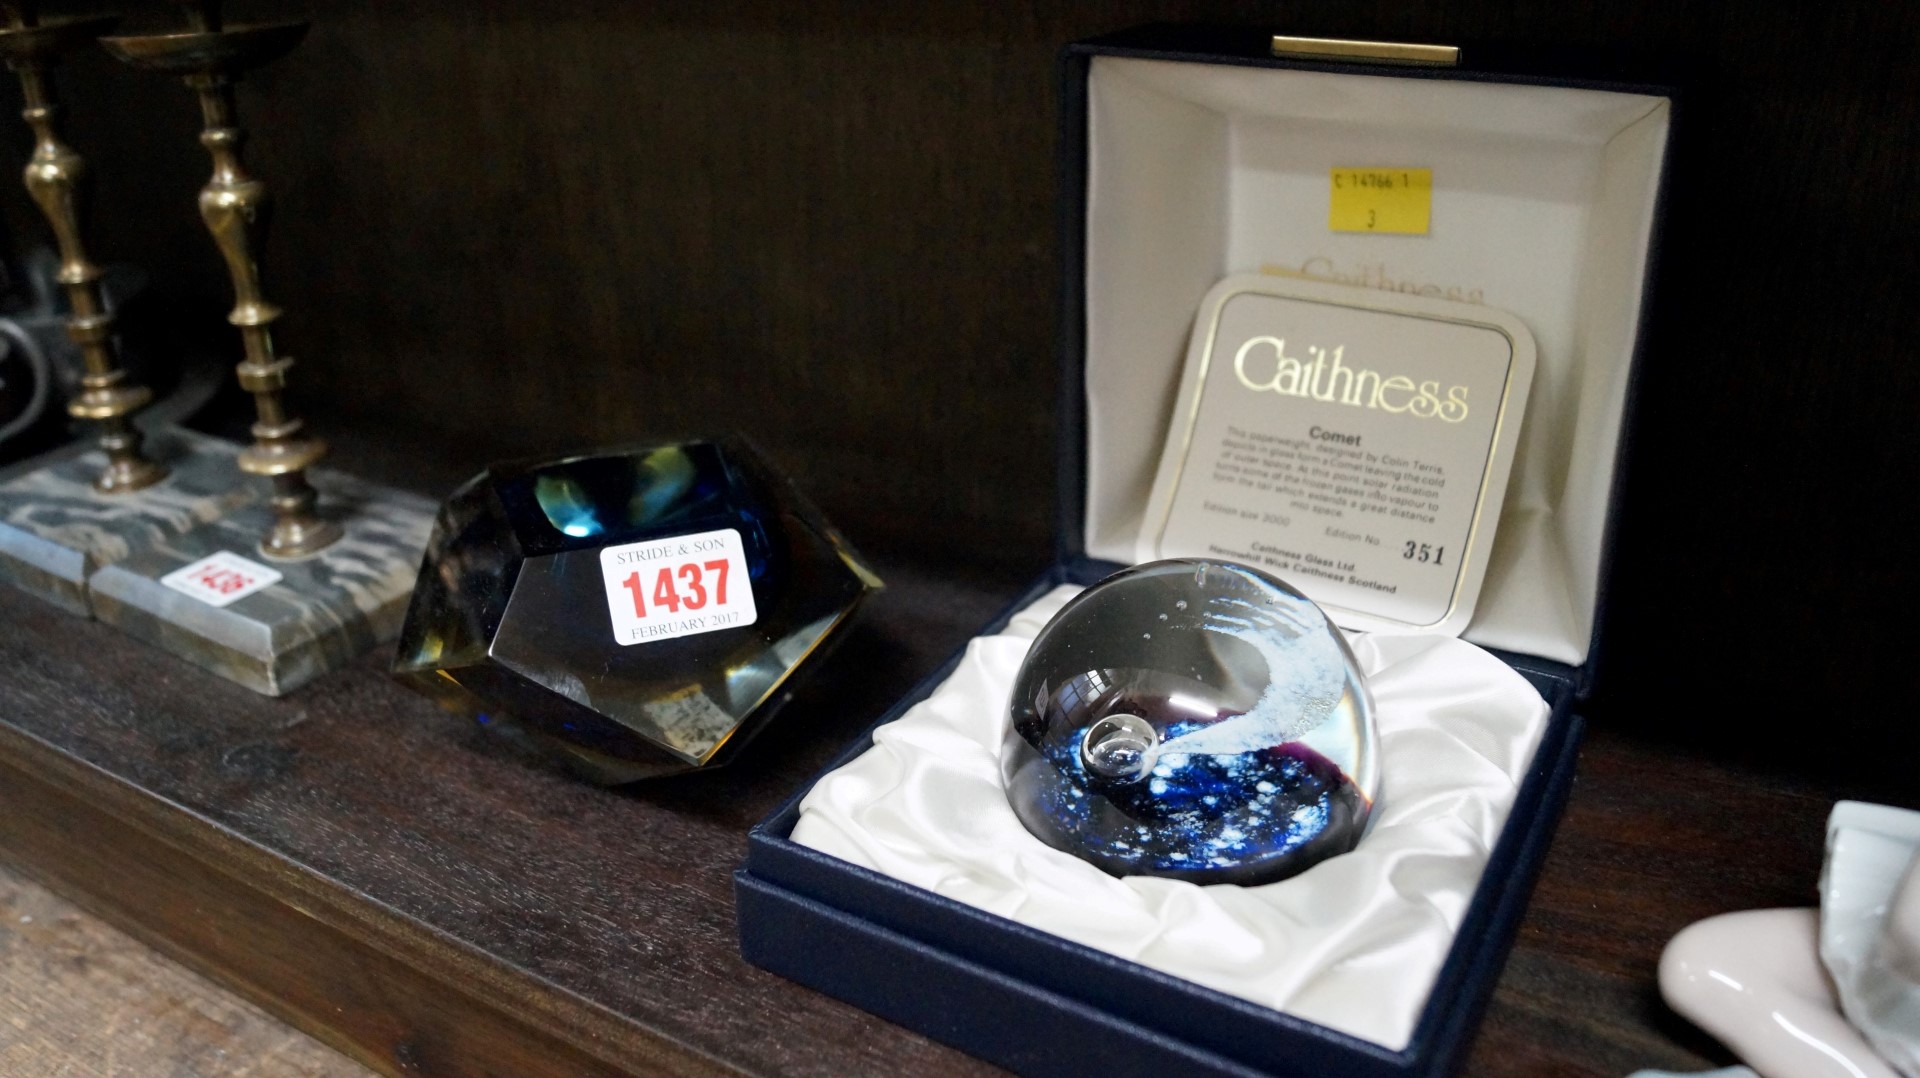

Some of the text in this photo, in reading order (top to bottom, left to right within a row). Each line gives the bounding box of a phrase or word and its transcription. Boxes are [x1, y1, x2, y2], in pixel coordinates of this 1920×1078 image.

[1366, 209, 1376, 229] 3
[1233, 335, 1469, 424] Caithness
[1308, 425, 1362, 448] Comet
[1269, 448, 1296, 459] glass
[1297, 451, 1321, 463] form
[1330, 458, 1363, 471] Comet
[1364, 466, 1402, 481] leaving
[1403, 472, 1421, 483] the
[1421, 477, 1446, 488] cold
[1316, 444, 1363, 460] designed
[1365, 452, 1378, 463] by
[1381, 454, 1410, 467] Colin
[1311, 467, 1330, 478] this
[1332, 472, 1360, 484] point
[1362, 478, 1388, 489] solar
[1391, 484, 1440, 499] radiation
[1275, 486, 1305, 497] which
[1307, 493, 1348, 506] extends
[1360, 503, 1389, 514] great
[1389, 509, 1436, 524] distance
[1334, 486, 1365, 497] gases
[1389, 496, 1427, 509] vapour
[1427, 502, 1440, 513] to
[616, 537, 726, 565] STRIDE & SON
[1250, 541, 1302, 560] Caithness
[1304, 553, 1335, 568] Glass
[1324, 527, 1362, 542] Edition
[1403, 540, 1445, 566] 351
[622, 558, 730, 619] 1437
[1264, 557, 1291, 570] Wick
[1292, 563, 1346, 583] Caithness
[1348, 577, 1397, 593] Scotland
[631, 611, 740, 640] FEBRUARY 2017
